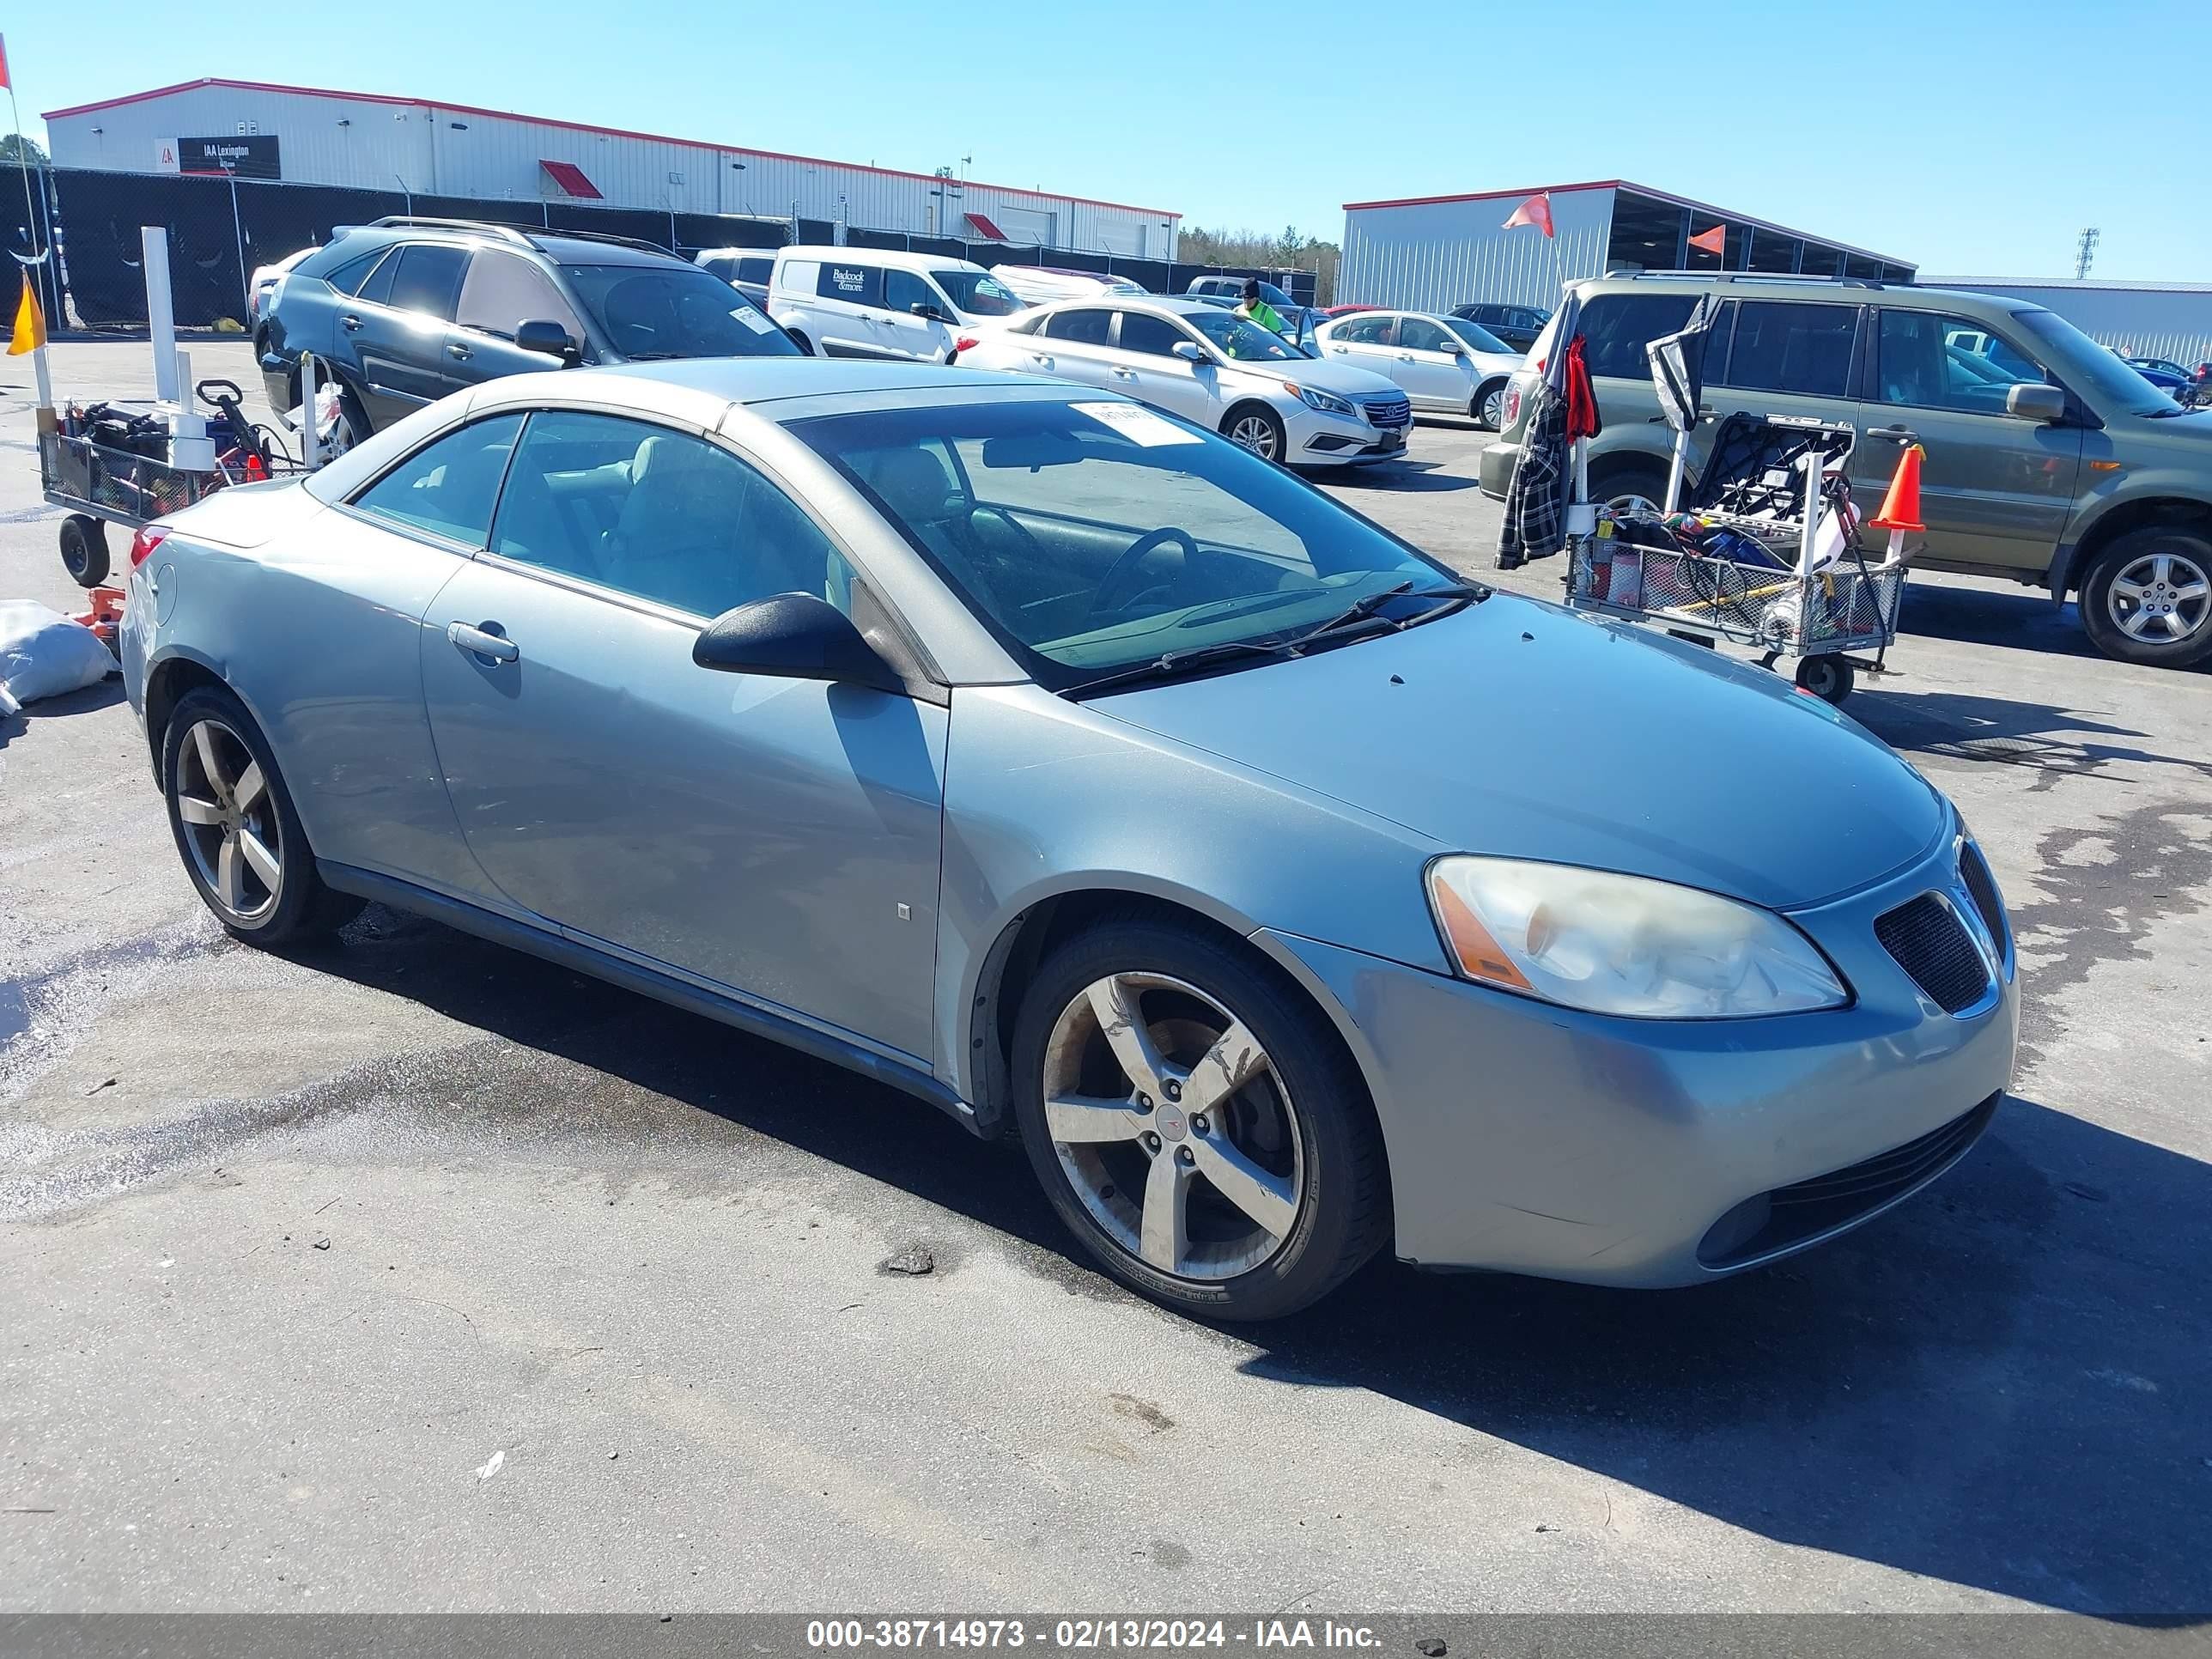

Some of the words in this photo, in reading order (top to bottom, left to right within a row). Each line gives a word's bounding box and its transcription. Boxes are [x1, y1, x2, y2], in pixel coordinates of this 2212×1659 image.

[204, 143, 216, 157] IAA
[217, 143, 250, 159] Lexington
[832, 268, 865, 282] Badcock
[838, 281, 864, 292] &more
